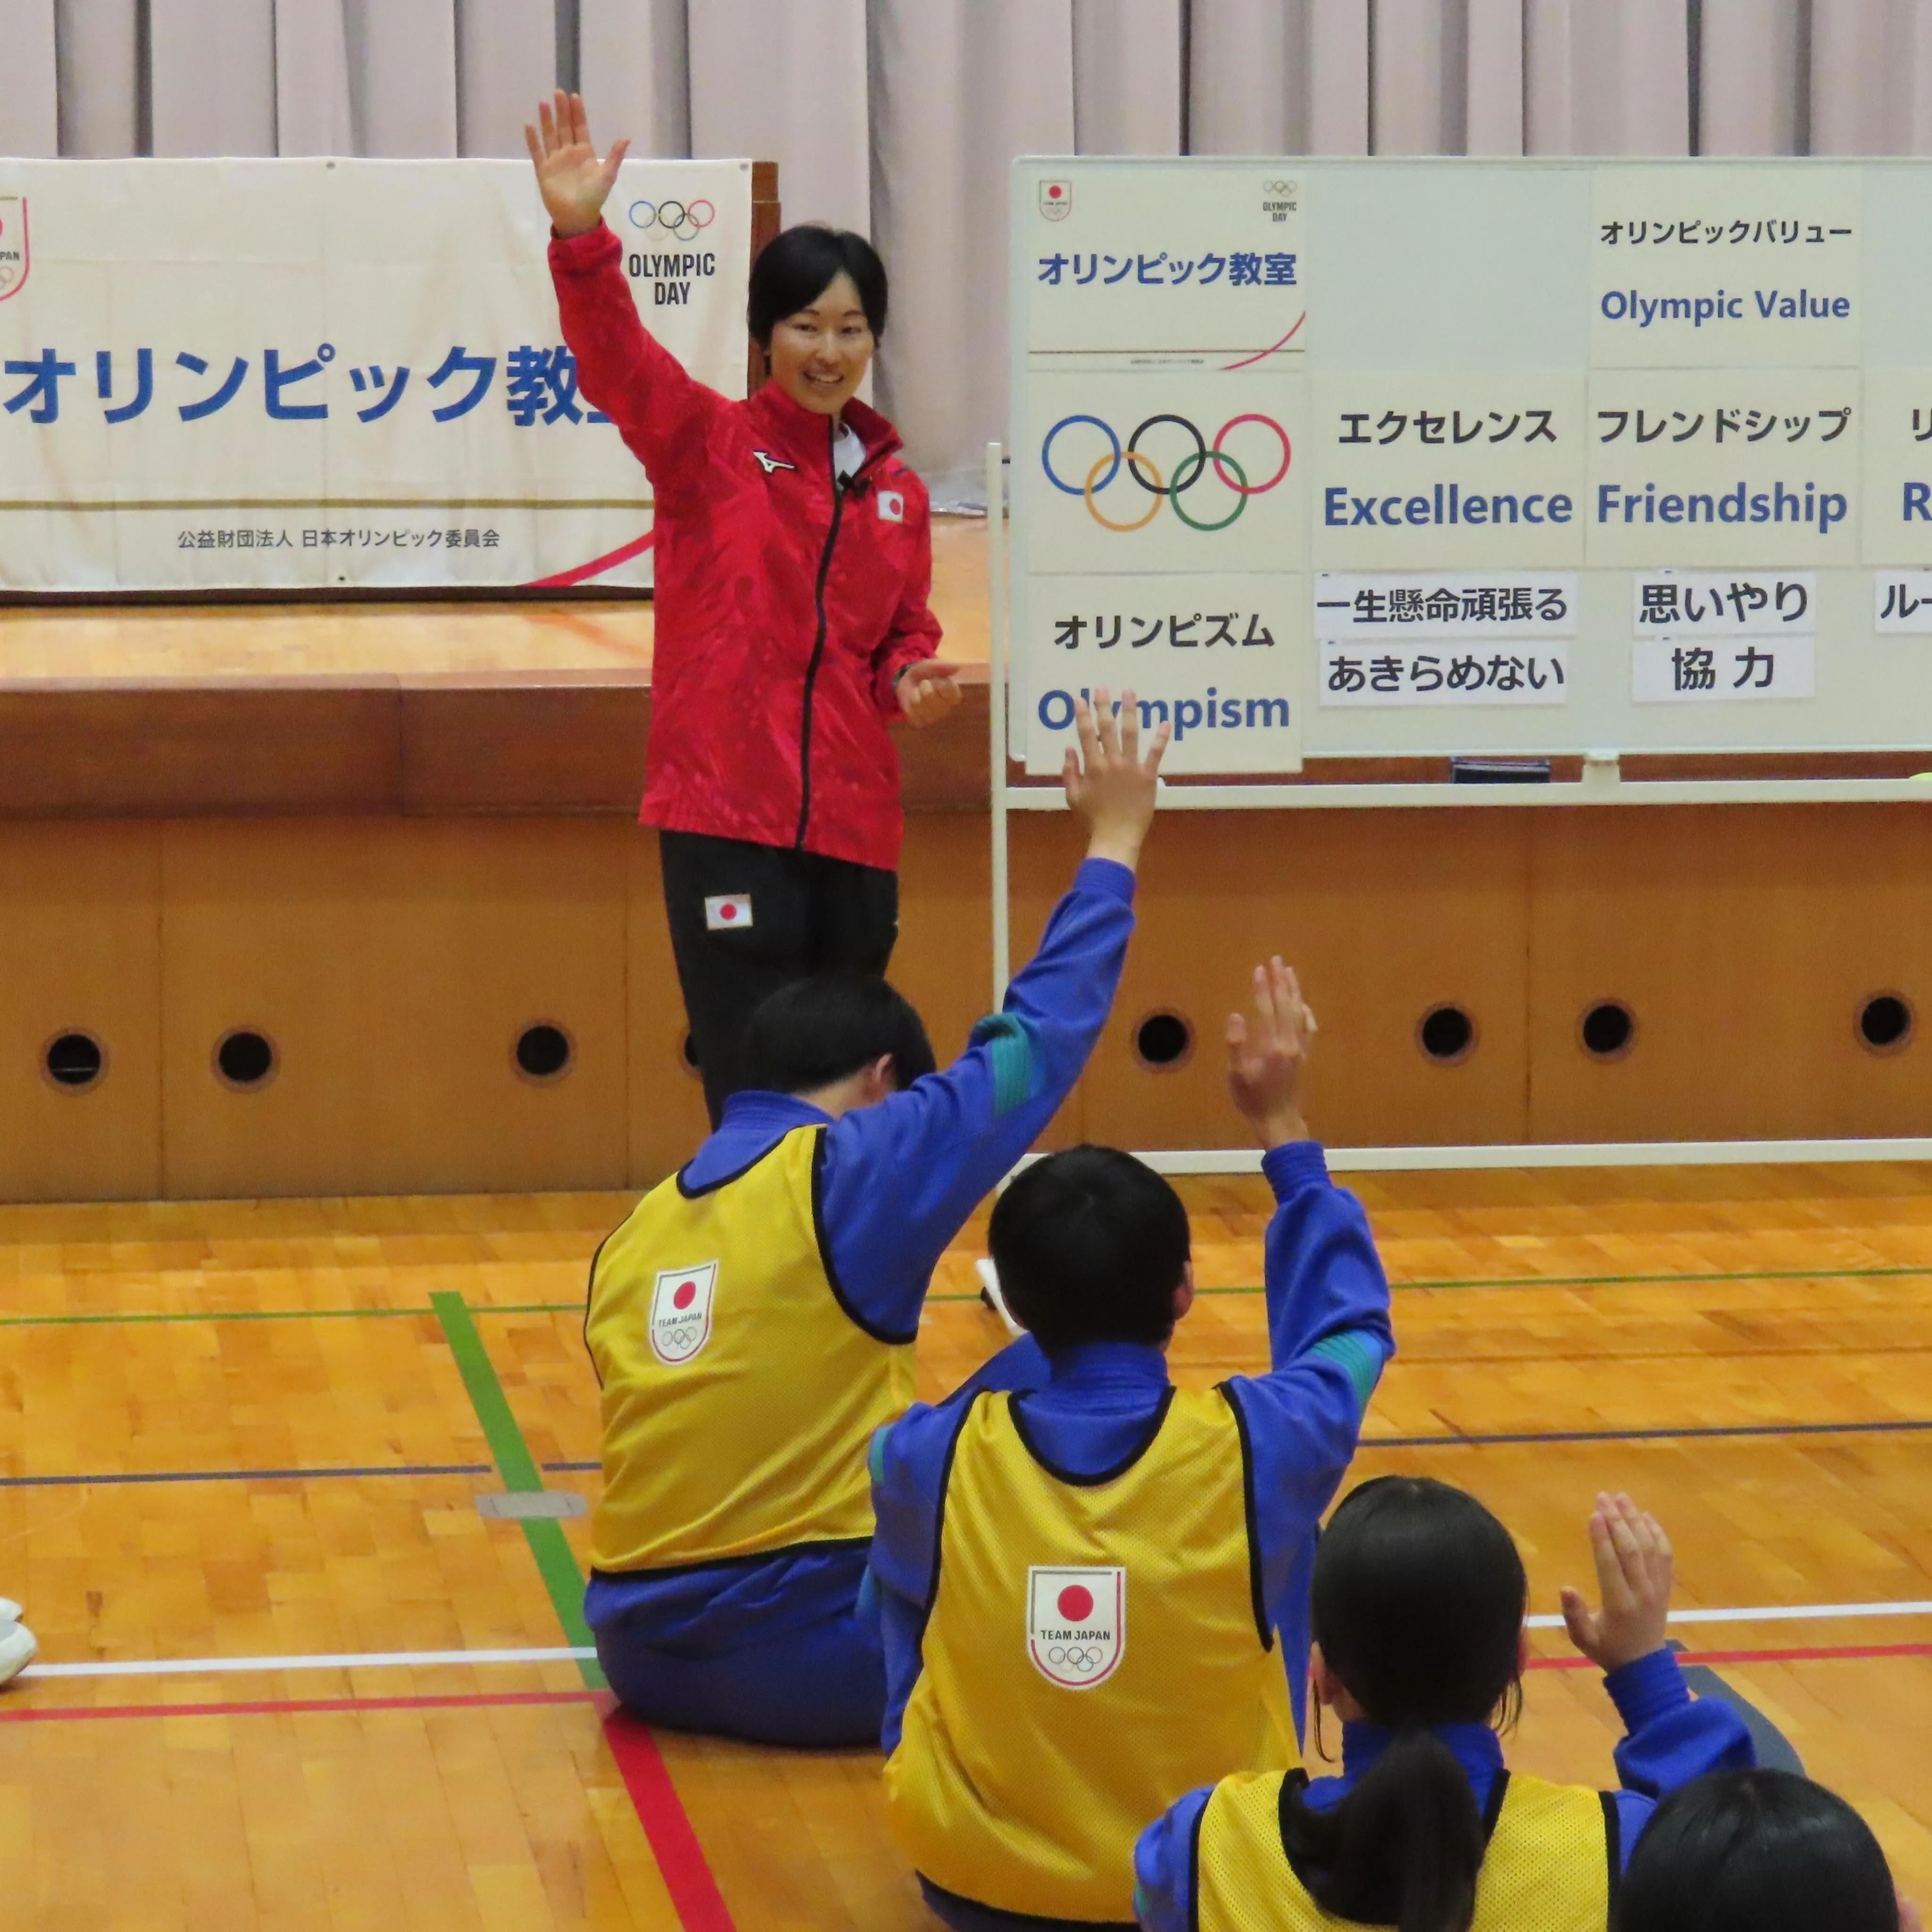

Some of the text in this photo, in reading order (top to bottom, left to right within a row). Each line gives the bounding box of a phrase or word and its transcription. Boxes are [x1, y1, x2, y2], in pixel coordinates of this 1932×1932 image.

[1263, 201, 1297, 211] OLYMPIC
[1272, 212, 1287, 222] DAY
[1600, 219, 1852, 245] オリンピックバリュー
[629, 253, 715, 277] OLYMPIC
[1038, 252, 1297, 286] オリンピック教室
[654, 282, 691, 305] DAY
[1601, 289, 1850, 327] Olympic Value
[3, 343, 613, 427] オリンピック教
[1339, 410, 1557, 445] エクセレンス
[1597, 407, 1852, 443] フレンドシップ
[1325, 483, 1573, 526] Excellence
[1598, 482, 1848, 534] Friendship
[178, 528, 500, 548] 公益財団法人 日本オリンピック委員会
[1317, 587, 1567, 623] 一生懸命頑張る
[1639, 582, 1807, 624] 思いやり
[1054, 612, 1275, 650] オリンピズム
[1328, 655, 1564, 692] あきらめない
[659, 1312, 702, 1328] TEAM JAPAN
[1041, 1630, 1110, 1641] TEAM JAPAN
